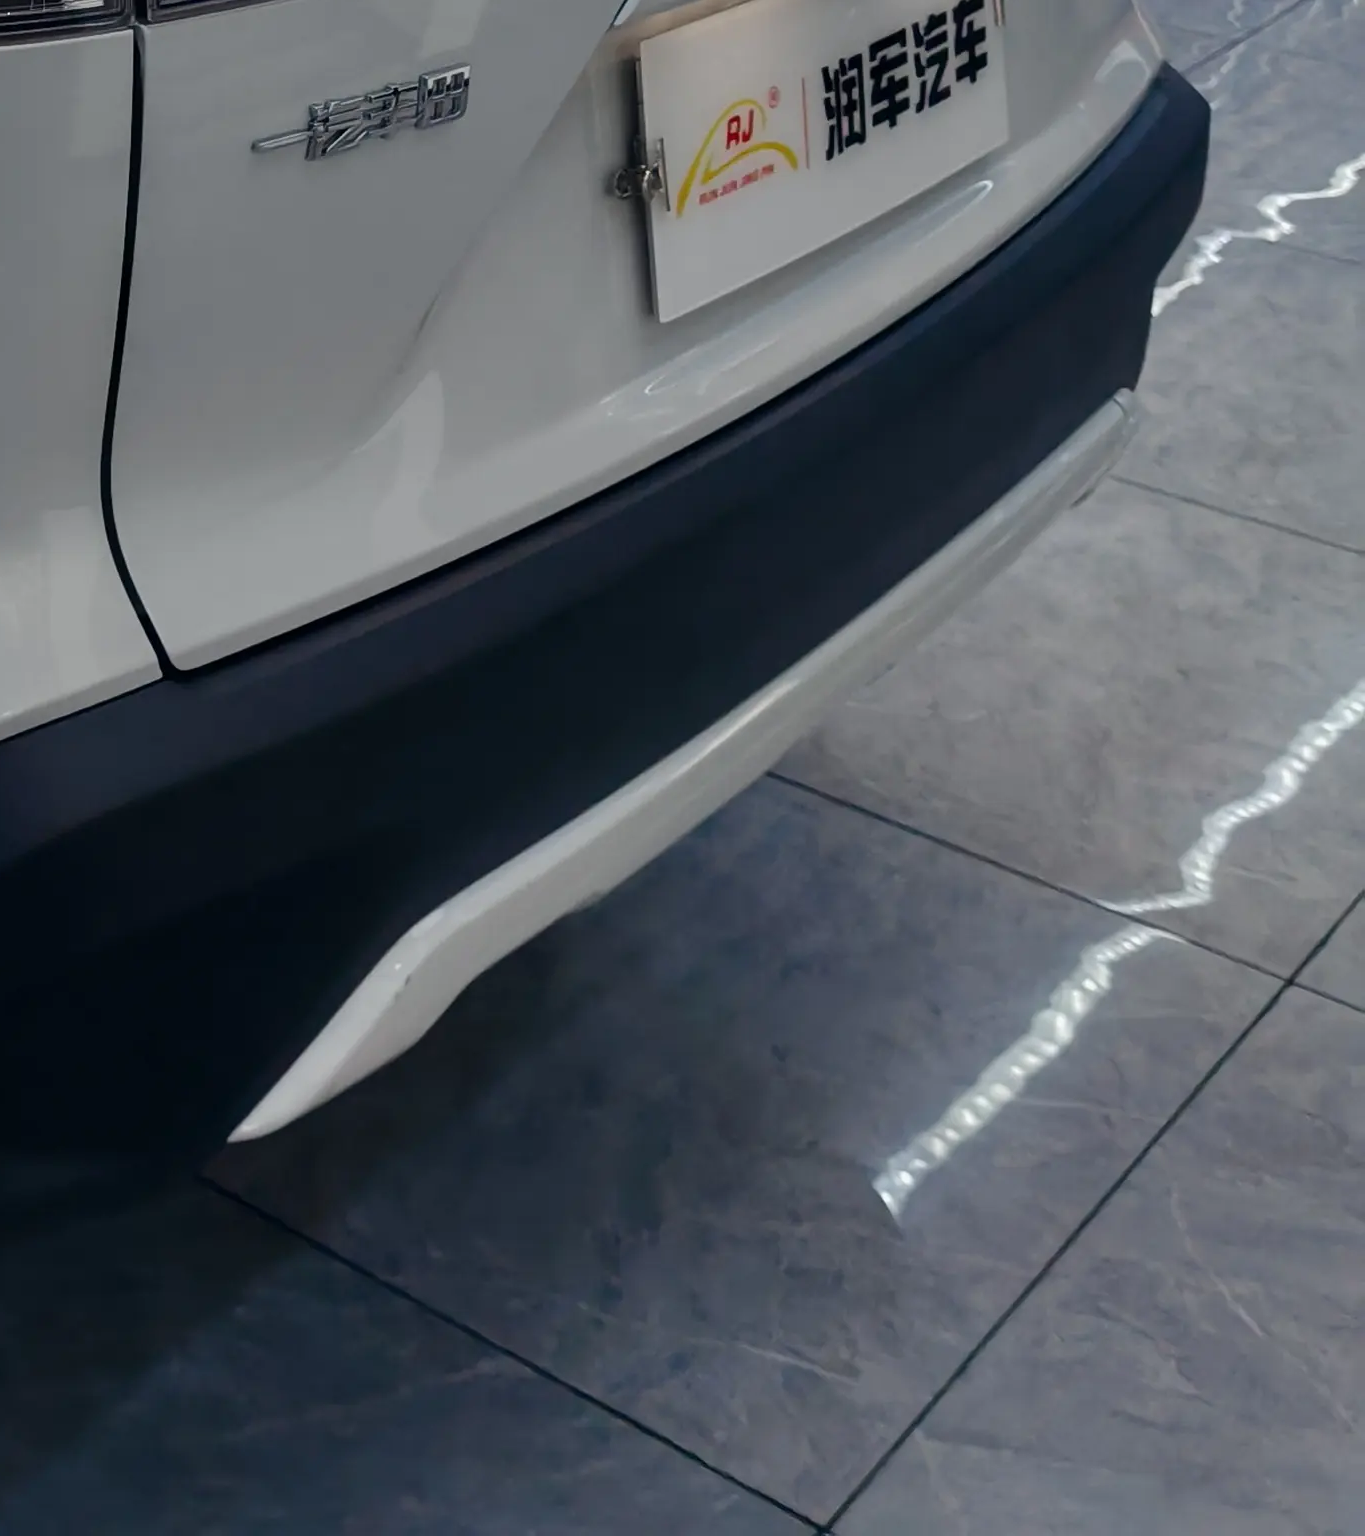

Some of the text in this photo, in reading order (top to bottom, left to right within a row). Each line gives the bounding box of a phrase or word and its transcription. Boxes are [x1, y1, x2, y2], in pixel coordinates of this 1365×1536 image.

[250, 62, 471, 162] 一汽丰田
[724, 107, 755, 151] RJ
